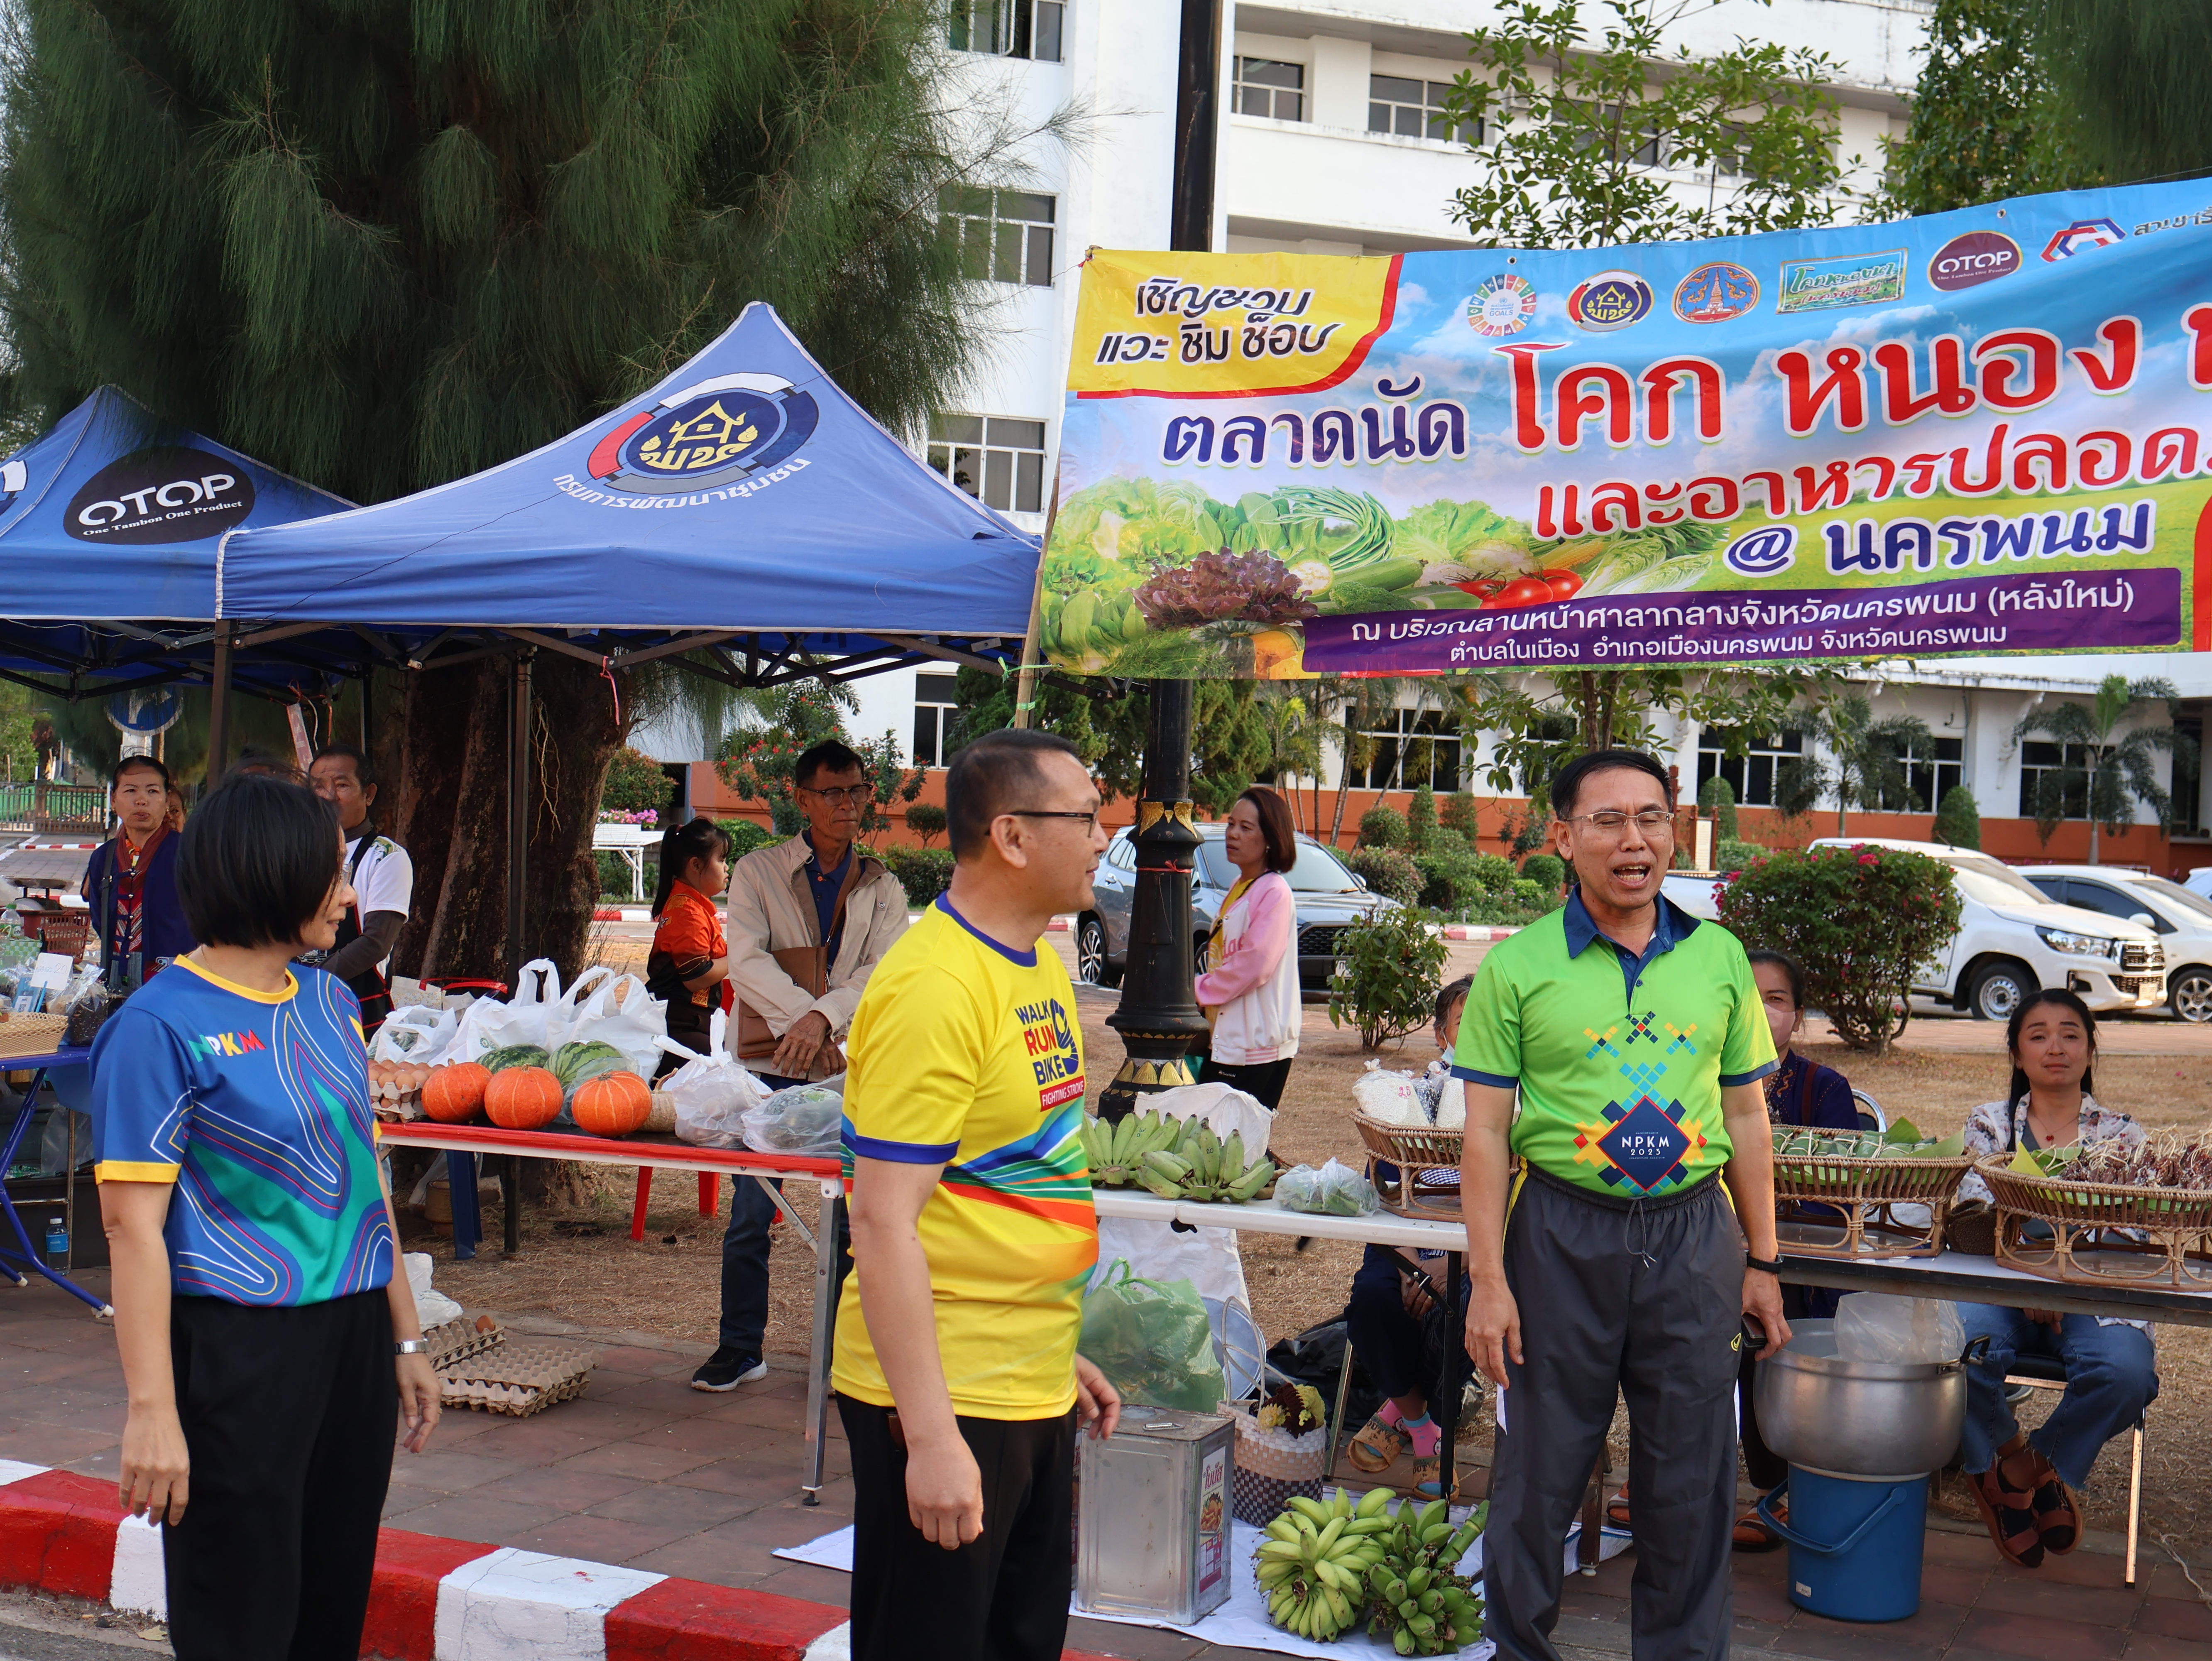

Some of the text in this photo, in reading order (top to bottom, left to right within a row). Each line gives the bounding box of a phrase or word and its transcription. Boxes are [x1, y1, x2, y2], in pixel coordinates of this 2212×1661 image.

[1938, 250, 2013, 273] OTOP
[1137, 278, 1312, 318] เชิญชวน
[1098, 313, 1341, 363] แวะ ชิม ช็อป
[1163, 376, 1466, 463] ตลาดนัด
[1494, 342, 1723, 450] โคก
[1776, 319, 2138, 433] หนอง
[553, 457, 812, 509] กรมการพัฒนาชุมชน
[1537, 424, 2212, 537] และอาหารปลอด
[78, 473, 235, 526] OTOP
[83, 500, 243, 536] One Tambon One Product
[1727, 504, 2150, 573] @ นครพนม
[1352, 578, 2135, 641] ณ บริเวณลานหน้าศาลากลางจังหวัดนครพนม (หลังใหม่)
[1450, 626, 2006, 661] ตำบลในเมือง อำเภอเมืองนครพนม จังหวัดนครพนม
[1014, 1000, 1051, 1026] WALK
[187, 1029, 267, 1062] NPKM
[1023, 1023, 1057, 1057] RUN
[1032, 1054, 1066, 1086] BIKE
[1042, 1080, 1084, 1107] FIGHTING STROKE
[1398, 1086, 1411, 1098] 25
[1622, 1136, 1669, 1148] NPKM
